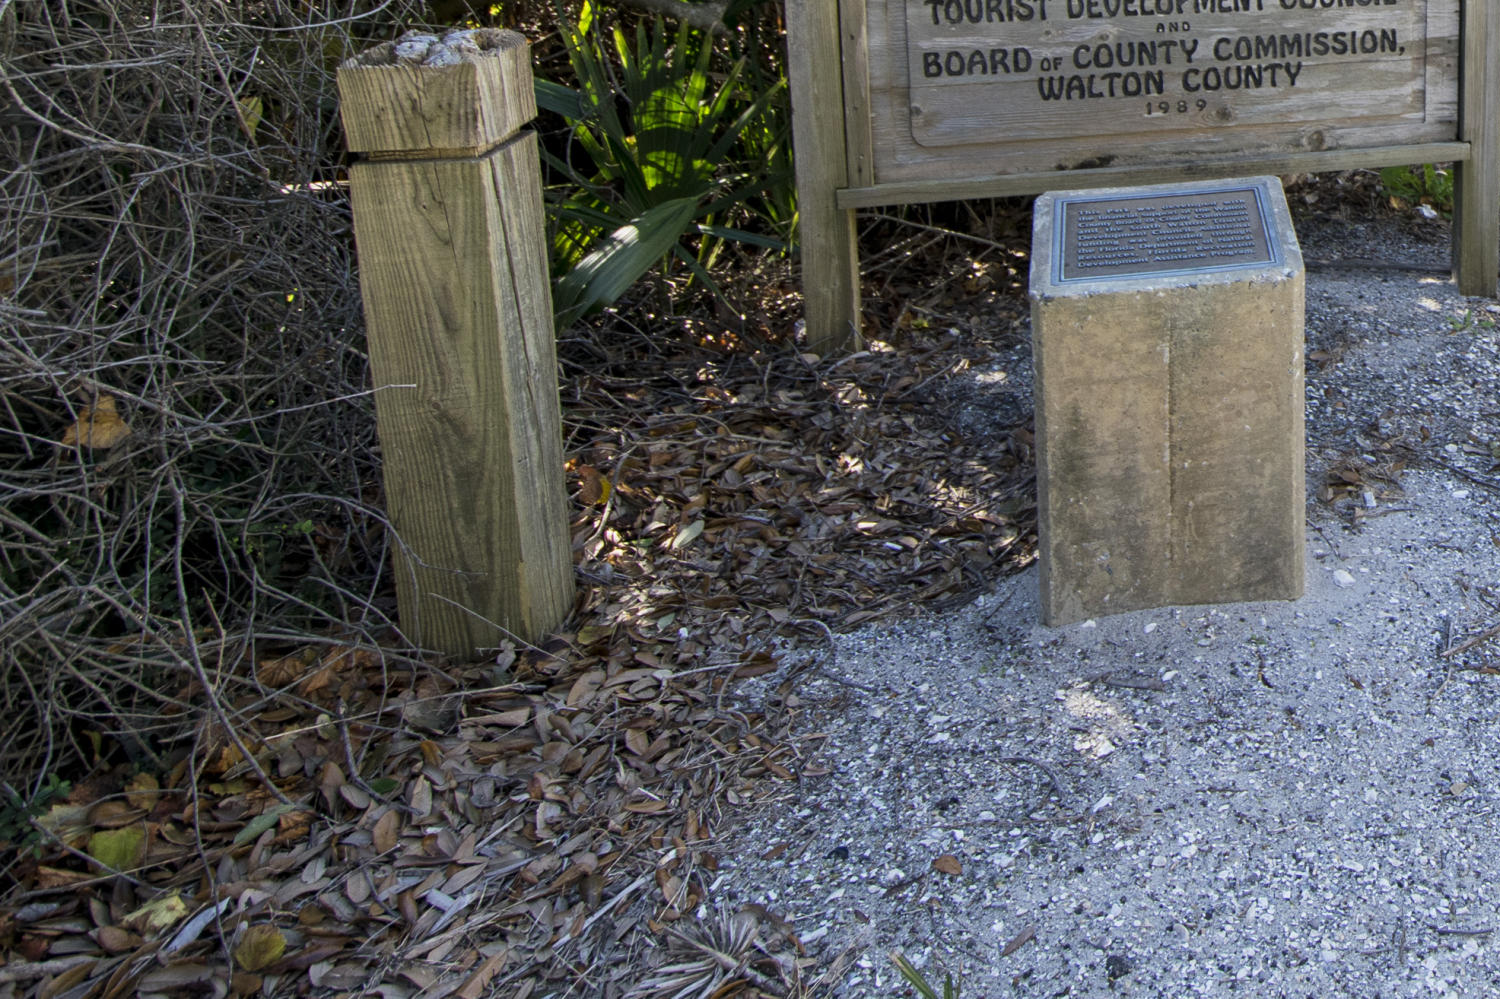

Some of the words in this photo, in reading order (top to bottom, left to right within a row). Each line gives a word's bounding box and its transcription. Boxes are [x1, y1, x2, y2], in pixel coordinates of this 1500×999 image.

[1156, 21, 1191, 33] AND
[923, 47, 1033, 78] BOARD
[1040, 57, 1063, 72] OF
[1073, 38, 1199, 70] COUNTY
[1213, 28, 1406, 61] COMMISSION,
[1038, 70, 1164, 101] WALTON
[1182, 62, 1302, 93] COUNTY
[1146, 99, 1207, 115] 1989
